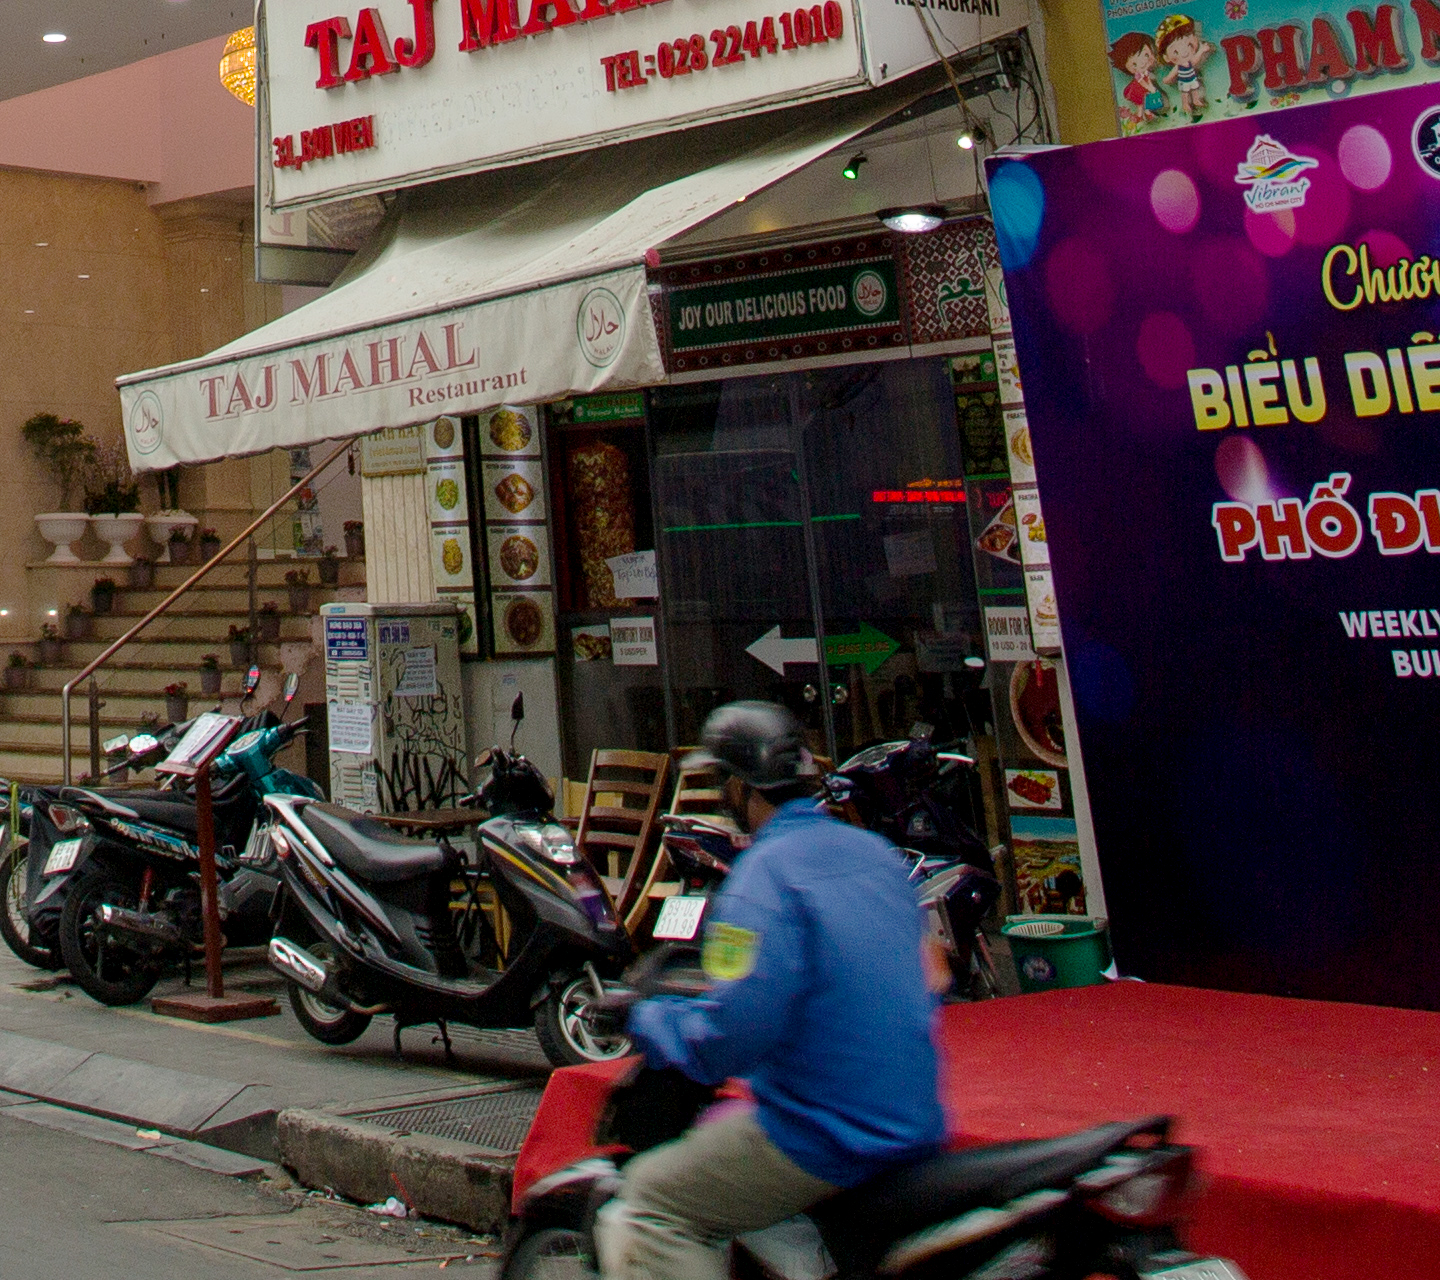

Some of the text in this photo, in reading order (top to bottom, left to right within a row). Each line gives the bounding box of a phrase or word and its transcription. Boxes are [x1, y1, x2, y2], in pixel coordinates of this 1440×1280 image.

[657, 33, 709, 80] 028
[710, 15, 779, 68] 2244
[1246, 180, 1308, 205] Vibrant
[678, 285, 846, 331] JOY OUR DELICIOUS FOOD
[200, 323, 480, 421] TAJ MAHAL
[408, 367, 527, 407] Restaurant
[1186, 330, 1326, 431] BIỂU
[1212, 472, 1363, 562] PHỐ
